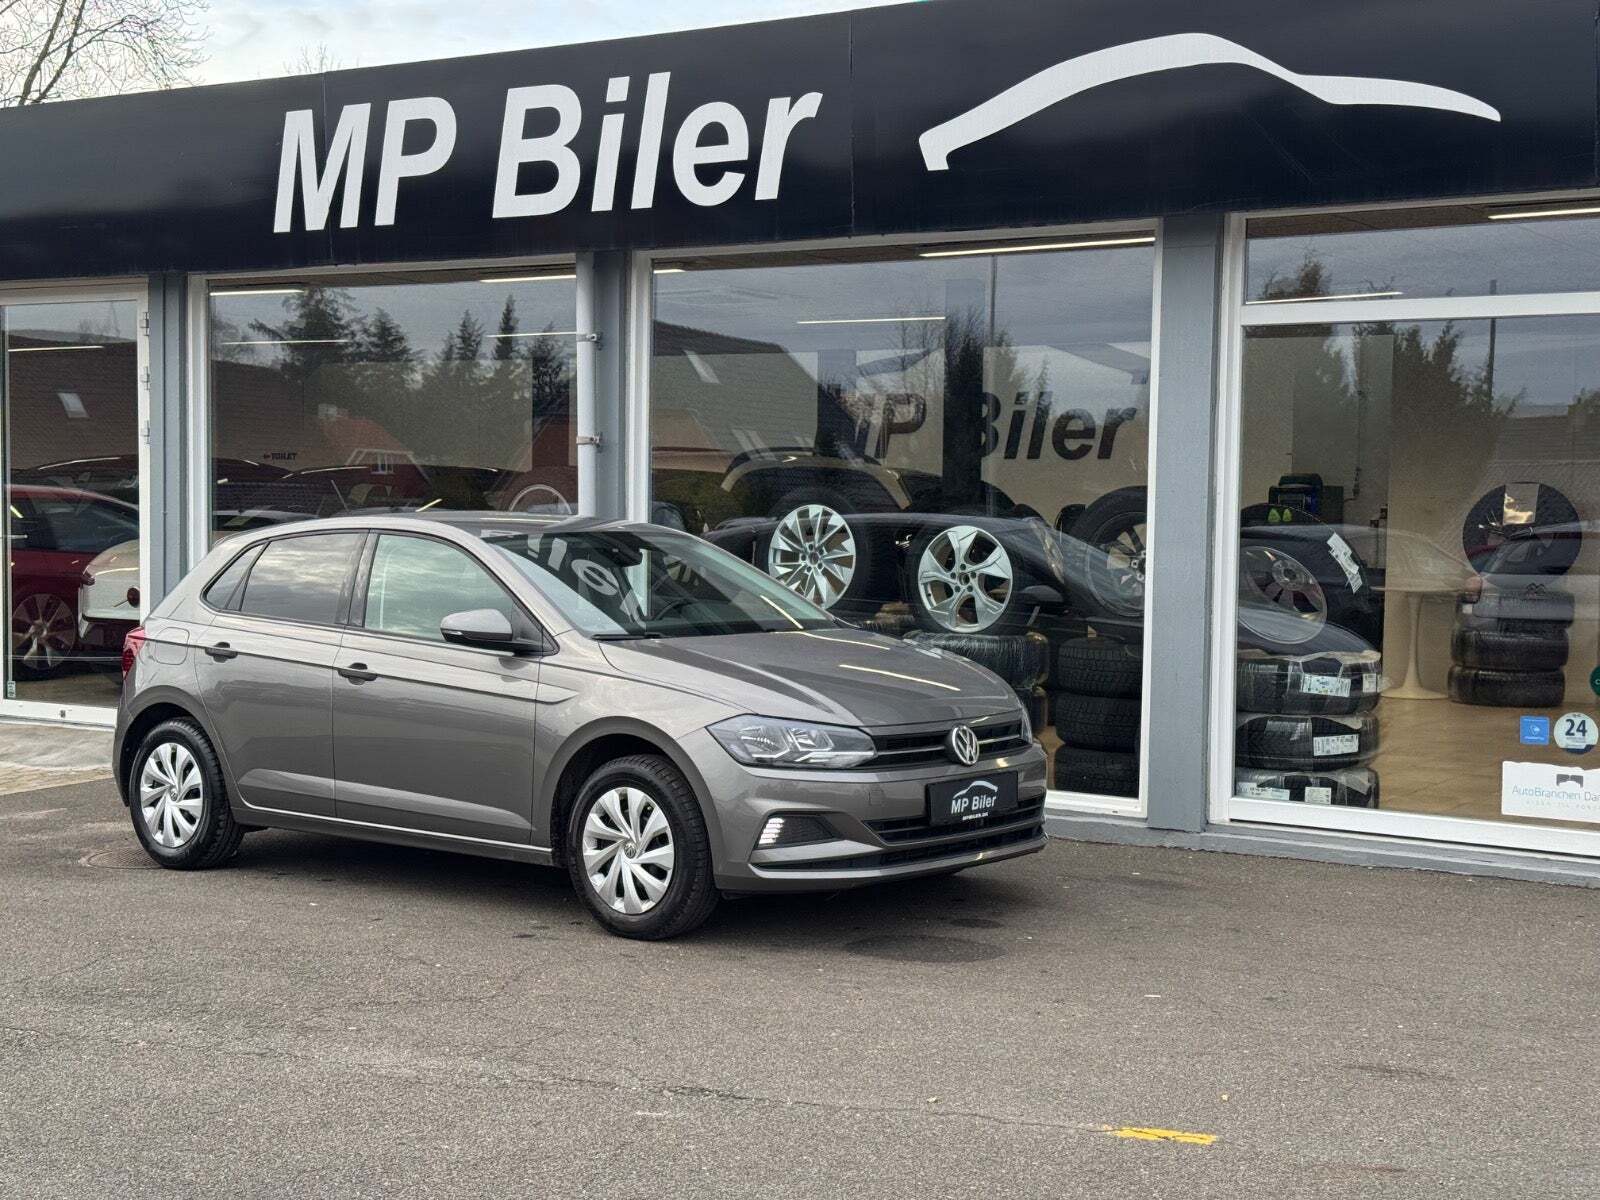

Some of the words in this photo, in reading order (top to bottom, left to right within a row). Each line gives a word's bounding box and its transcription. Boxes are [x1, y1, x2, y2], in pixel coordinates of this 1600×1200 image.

[273, 97, 457, 233] MP
[492, 71, 823, 219] Biler
[1565, 718, 1588, 737] 24
[951, 798, 969, 814] MP
[971, 795, 997, 811] Biler
